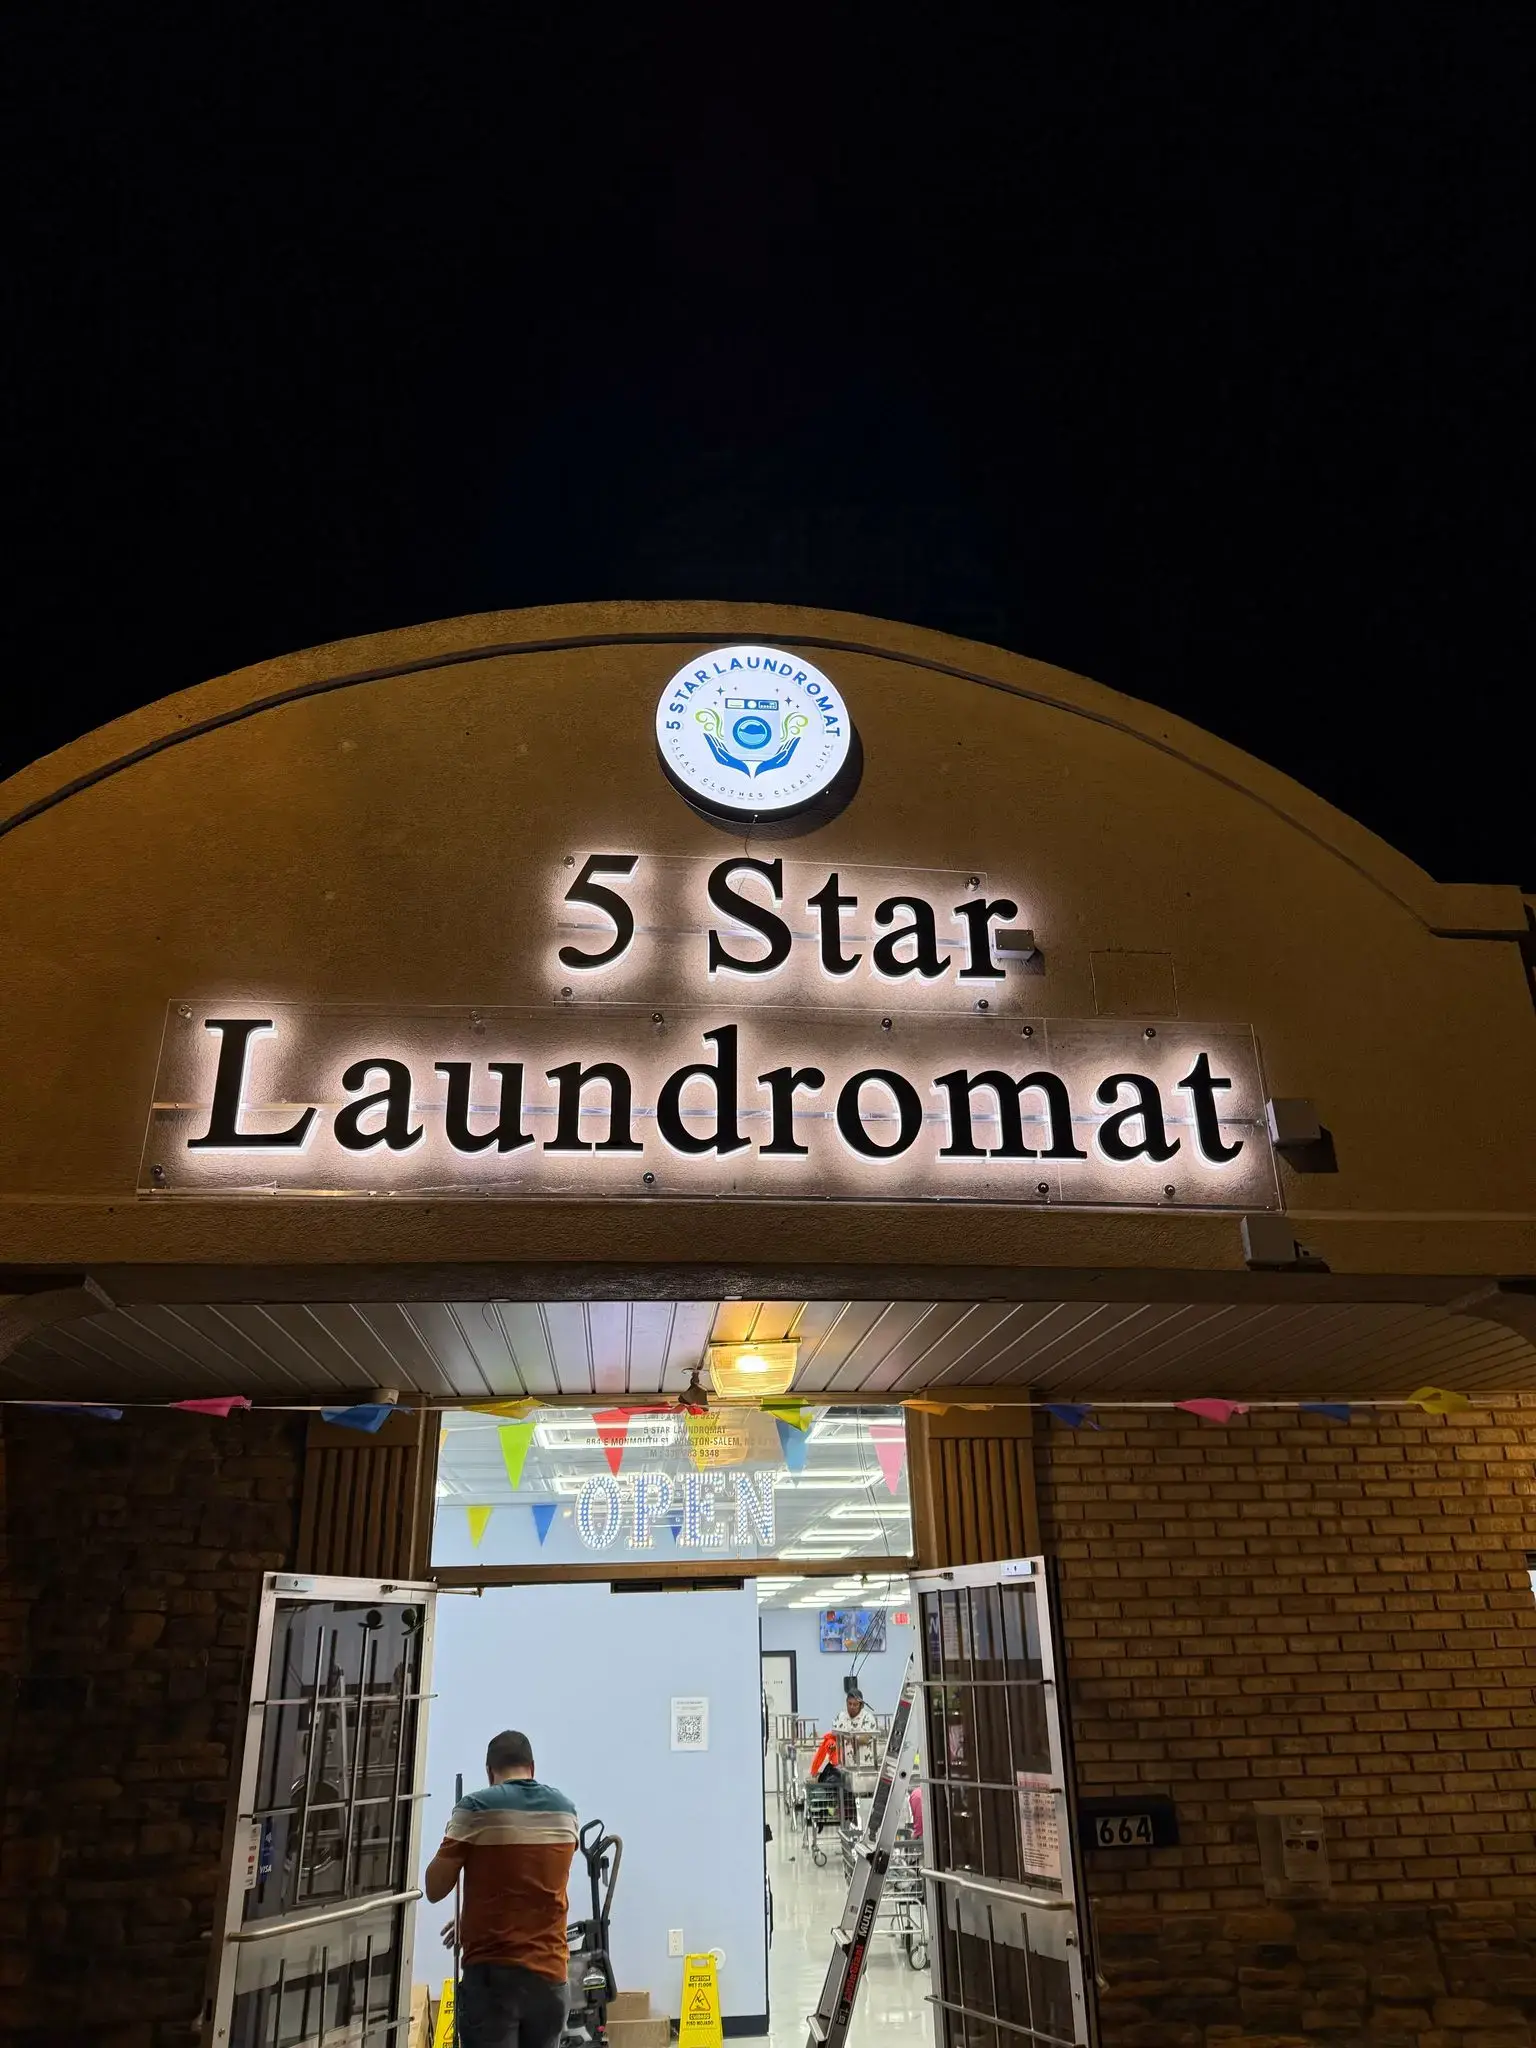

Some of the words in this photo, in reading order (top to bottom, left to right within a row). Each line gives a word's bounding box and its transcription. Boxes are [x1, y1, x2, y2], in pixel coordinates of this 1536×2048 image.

[669, 669, 711, 714] STAR
[713, 656, 841, 738] LAUNDROMAT
[666, 721, 681, 731] 5
[672, 738, 697, 774] CLEAN
[702, 777, 764, 798] CLOTHES
[774, 773, 812, 796] CLEAN
[558, 854, 640, 971] 5
[706, 857, 1018, 983] Star
[187, 1018, 1244, 1165] Laundromat
[604, 1437, 608, 1446] E
[652, 1426, 670, 1434] STAR
[673, 1425, 727, 1434] LAUNDROMAT
[699, 1449, 720, 1457] 9348
[575, 1470, 778, 1550] OPEN
[1099, 1816, 1152, 1844] 664
[858, 1905, 875, 1938] MULTI
